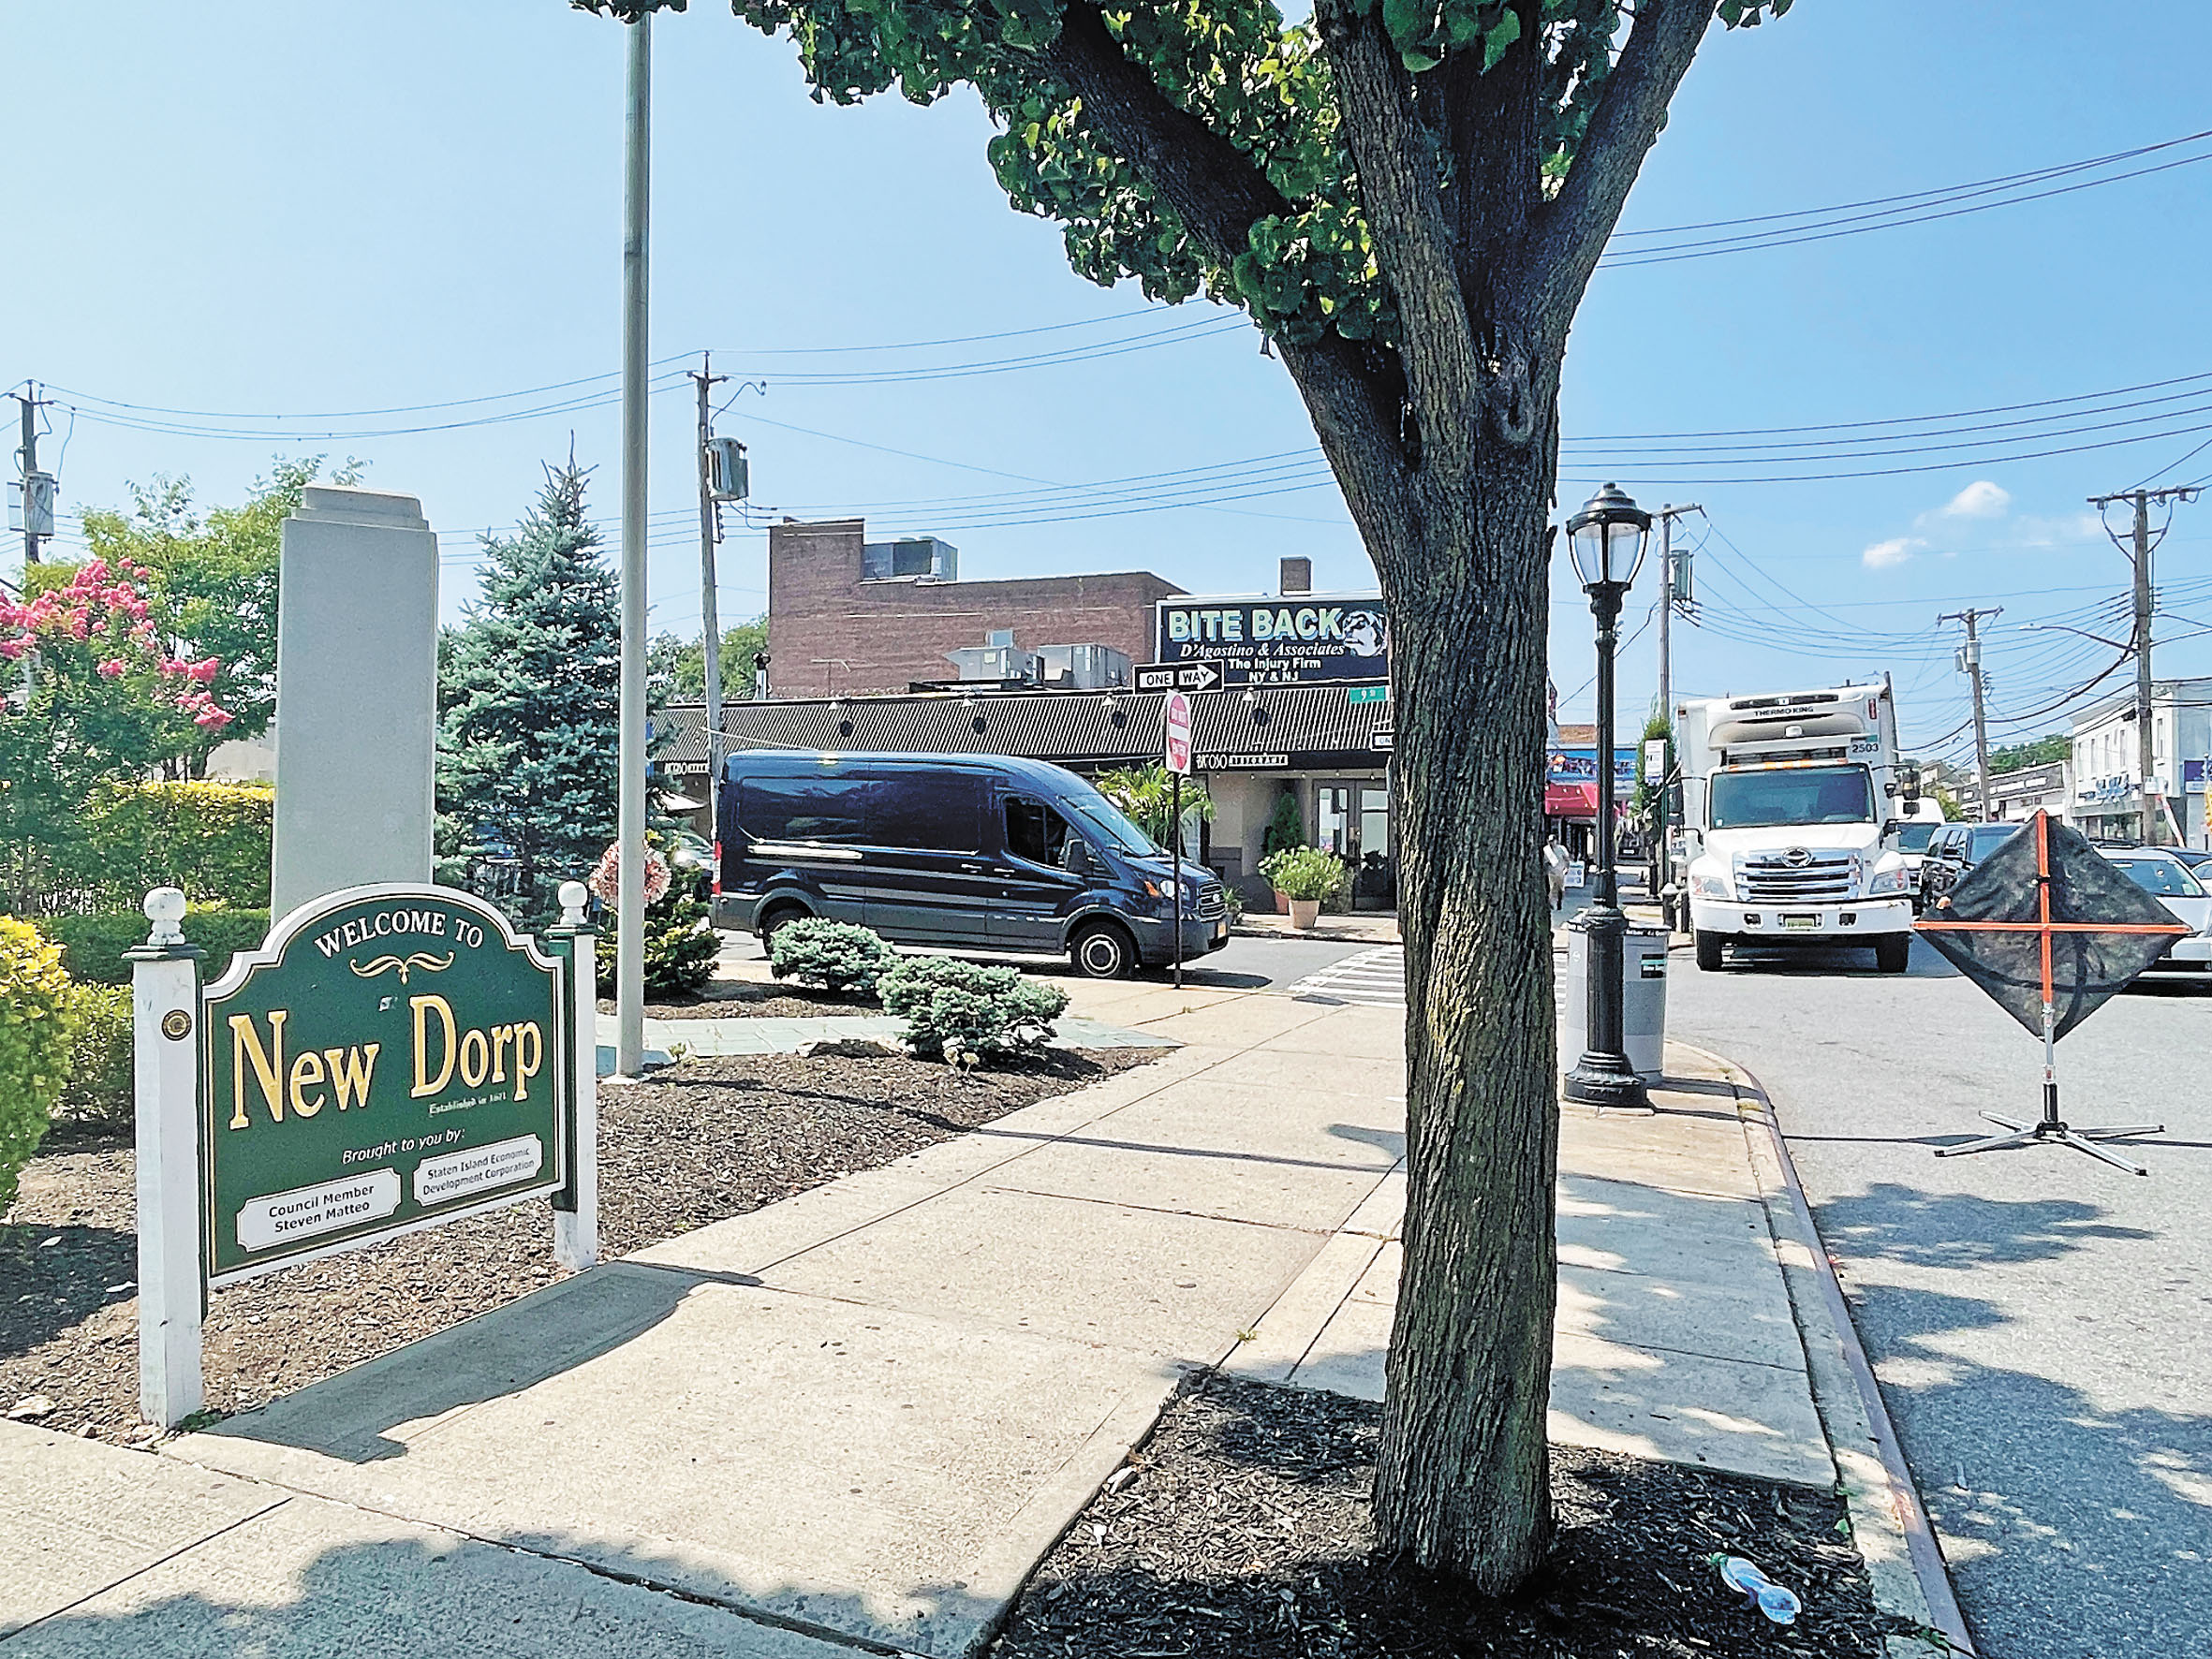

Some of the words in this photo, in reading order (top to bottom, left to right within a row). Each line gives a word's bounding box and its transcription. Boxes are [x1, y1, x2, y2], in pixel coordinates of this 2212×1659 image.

[1169, 609, 1244, 642] BITE
[1251, 608, 1345, 641] BACK
[1180, 643, 1254, 660] D'Agostino
[1258, 643, 1270, 656] &
[1273, 642, 1345, 656] Associates
[1228, 658, 1251, 669] The
[1254, 658, 1290, 672] Injury
[1292, 657, 1321, 668] Firm
[1146, 673, 1172, 685] ONE
[1183, 670, 1209, 683] WAY
[1248, 671, 1265, 683] NY
[1270, 671, 1279, 682] &
[1281, 671, 1300, 682] NJ
[1754, 708, 1792, 717] THERMO
[1851, 743, 1880, 754] 2503
[314, 910, 447, 959] WELCOME
[455, 918, 484, 948] TO
[228, 1009, 379, 1130] New
[409, 994, 542, 1102] Dorp
[429, 1096, 477, 1116] Established
[342, 1141, 398, 1165] Brought
[401, 1138, 415, 1152] to
[418, 1132, 442, 1151] you
[445, 1128, 465, 1145] by:
[423, 1172, 484, 1196] Development
[485, 1159, 535, 1179] Corporation
[427, 1165, 458, 1180] Staten
[460, 1156, 489, 1172] Island
[491, 1148, 530, 1165] Economic
[269, 1197, 319, 1218] Council
[323, 1184, 375, 1205] Member
[274, 1214, 321, 1233] Steven
[326, 1201, 370, 1220] Matteo
